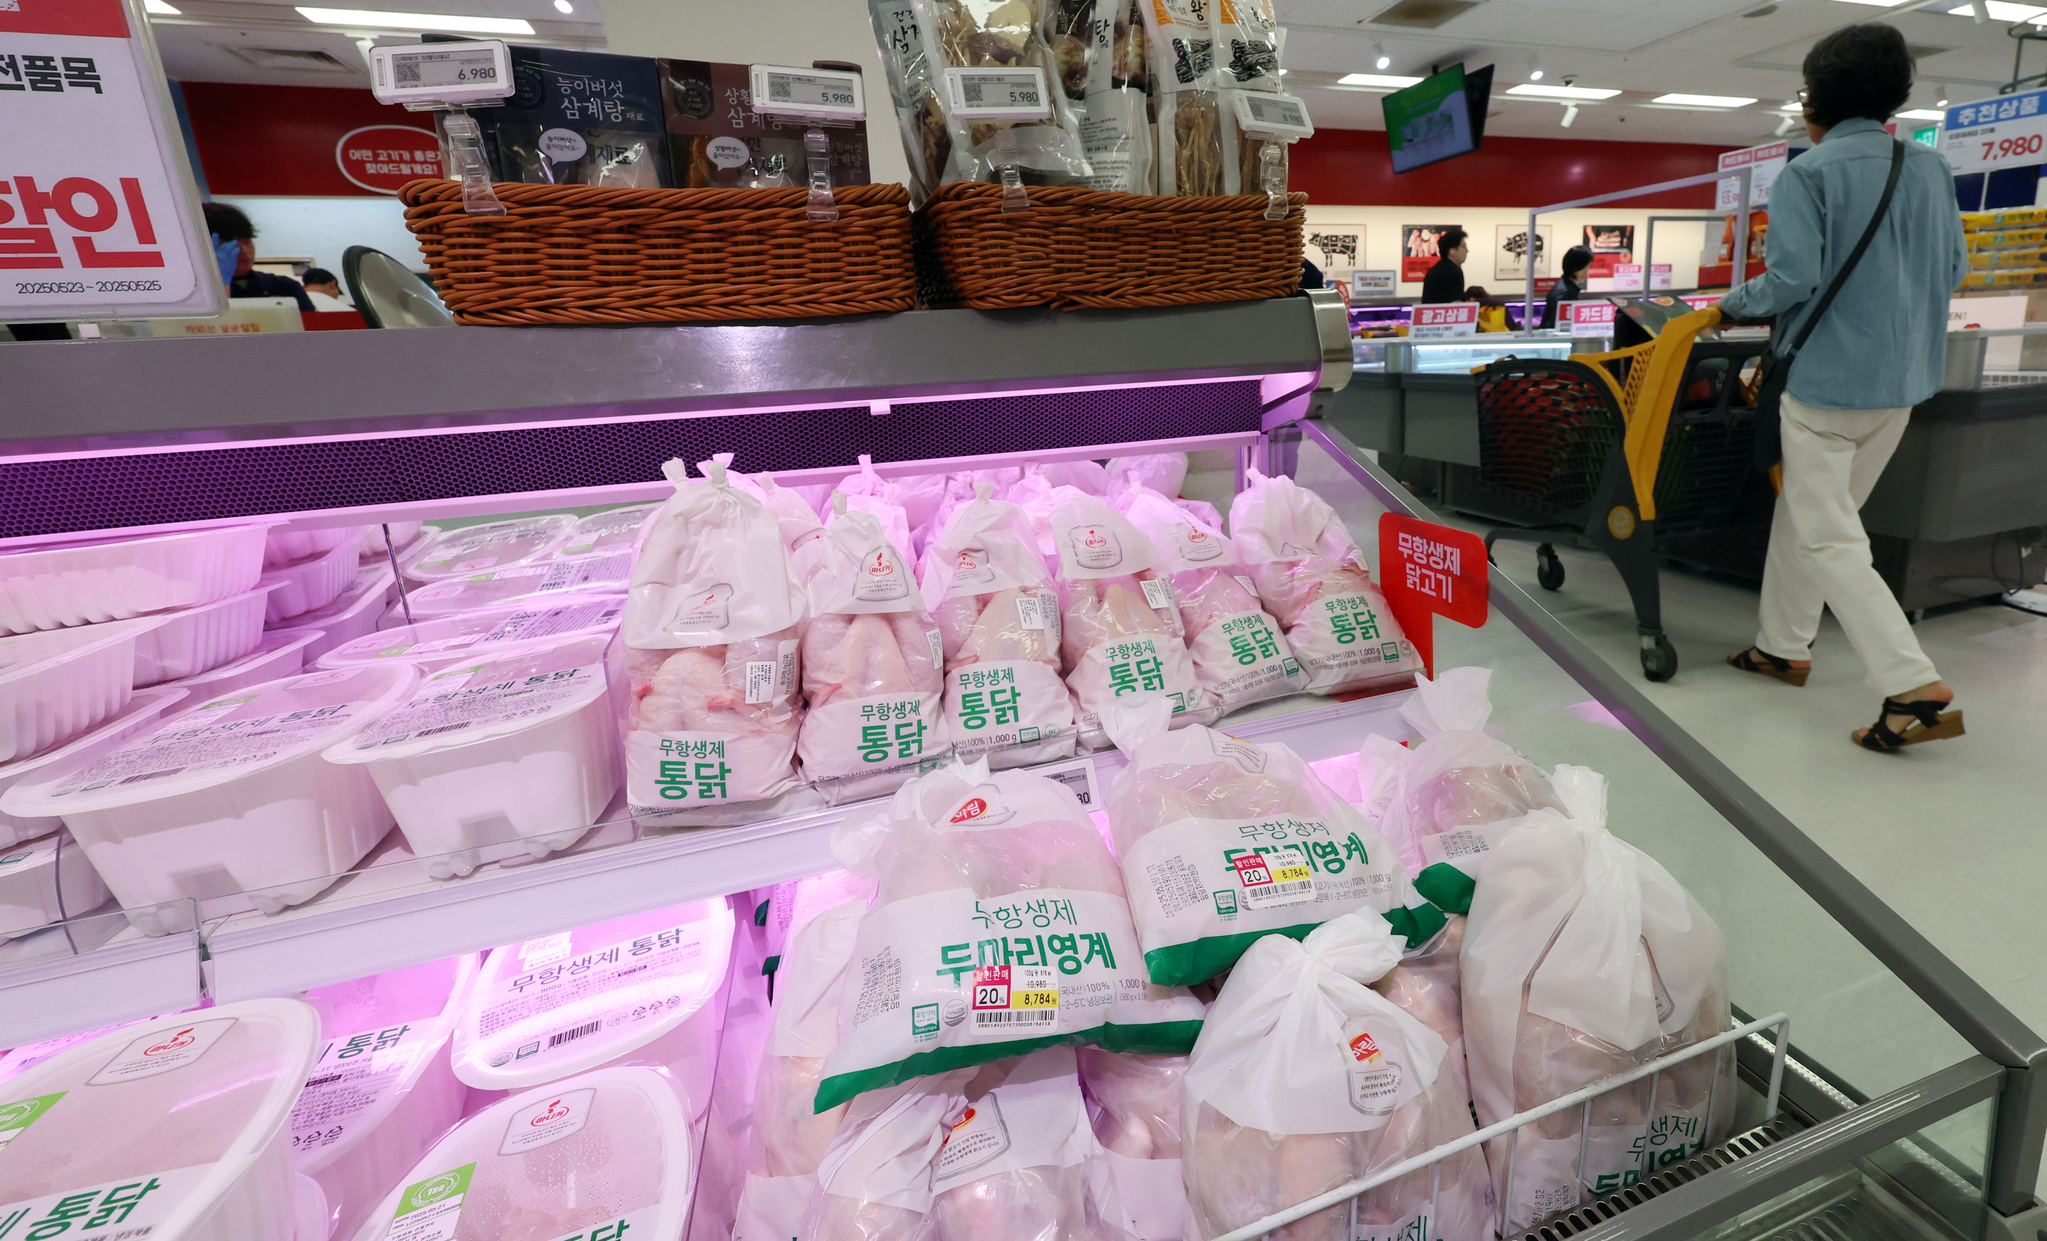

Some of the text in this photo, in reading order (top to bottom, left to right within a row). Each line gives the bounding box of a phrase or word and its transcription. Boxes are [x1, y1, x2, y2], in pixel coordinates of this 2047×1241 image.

[458, 67, 496, 81] 6.980
[556, 77, 624, 98] 능이버섯
[822, 92, 854, 104] 5.980
[1010, 92, 1038, 103] 5.980
[561, 97, 645, 122] 삼계탕 재료
[1958, 96, 2040, 125] 추천상품
[1981, 134, 2043, 160] 7,980
[1421, 307, 1469, 324] 광고상품
[1398, 531, 1460, 576] 무항생제
[1406, 562, 1452, 603] 닭고기
[1325, 596, 1369, 613] 무항생제
[1222, 613, 1265, 635] 무항생제
[1330, 609, 1377, 644] 통닭
[1106, 639, 1156, 662] 무항생제
[1229, 626, 1280, 665] 통닭
[959, 667, 1015, 690] 무항생제
[1108, 656, 1164, 697] 통닭
[861, 700, 921, 721] 무항생제
[959, 686, 1021, 729] 통닭
[659, 739, 725, 759] 무항생제
[857, 719, 927, 763] 통닭
[655, 760, 731, 800] 통닭
[1239, 819, 1330, 842] 무항생제
[1235, 857, 1263, 868] 할인판매
[628, 928, 684, 956] 통닭
[507, 947, 619, 993] 무항생제
[937, 932, 1117, 988] 두마리영계
[976, 969, 1009, 982] 할인판매
[338, 1025, 411, 1059] 통닭
[1353, 1037, 1378, 1057] 하림
[536, 1110, 565, 1124] 마니커
[1627, 1115, 1698, 1162] 무생제
[25, 1177, 161, 1240] 통닭
